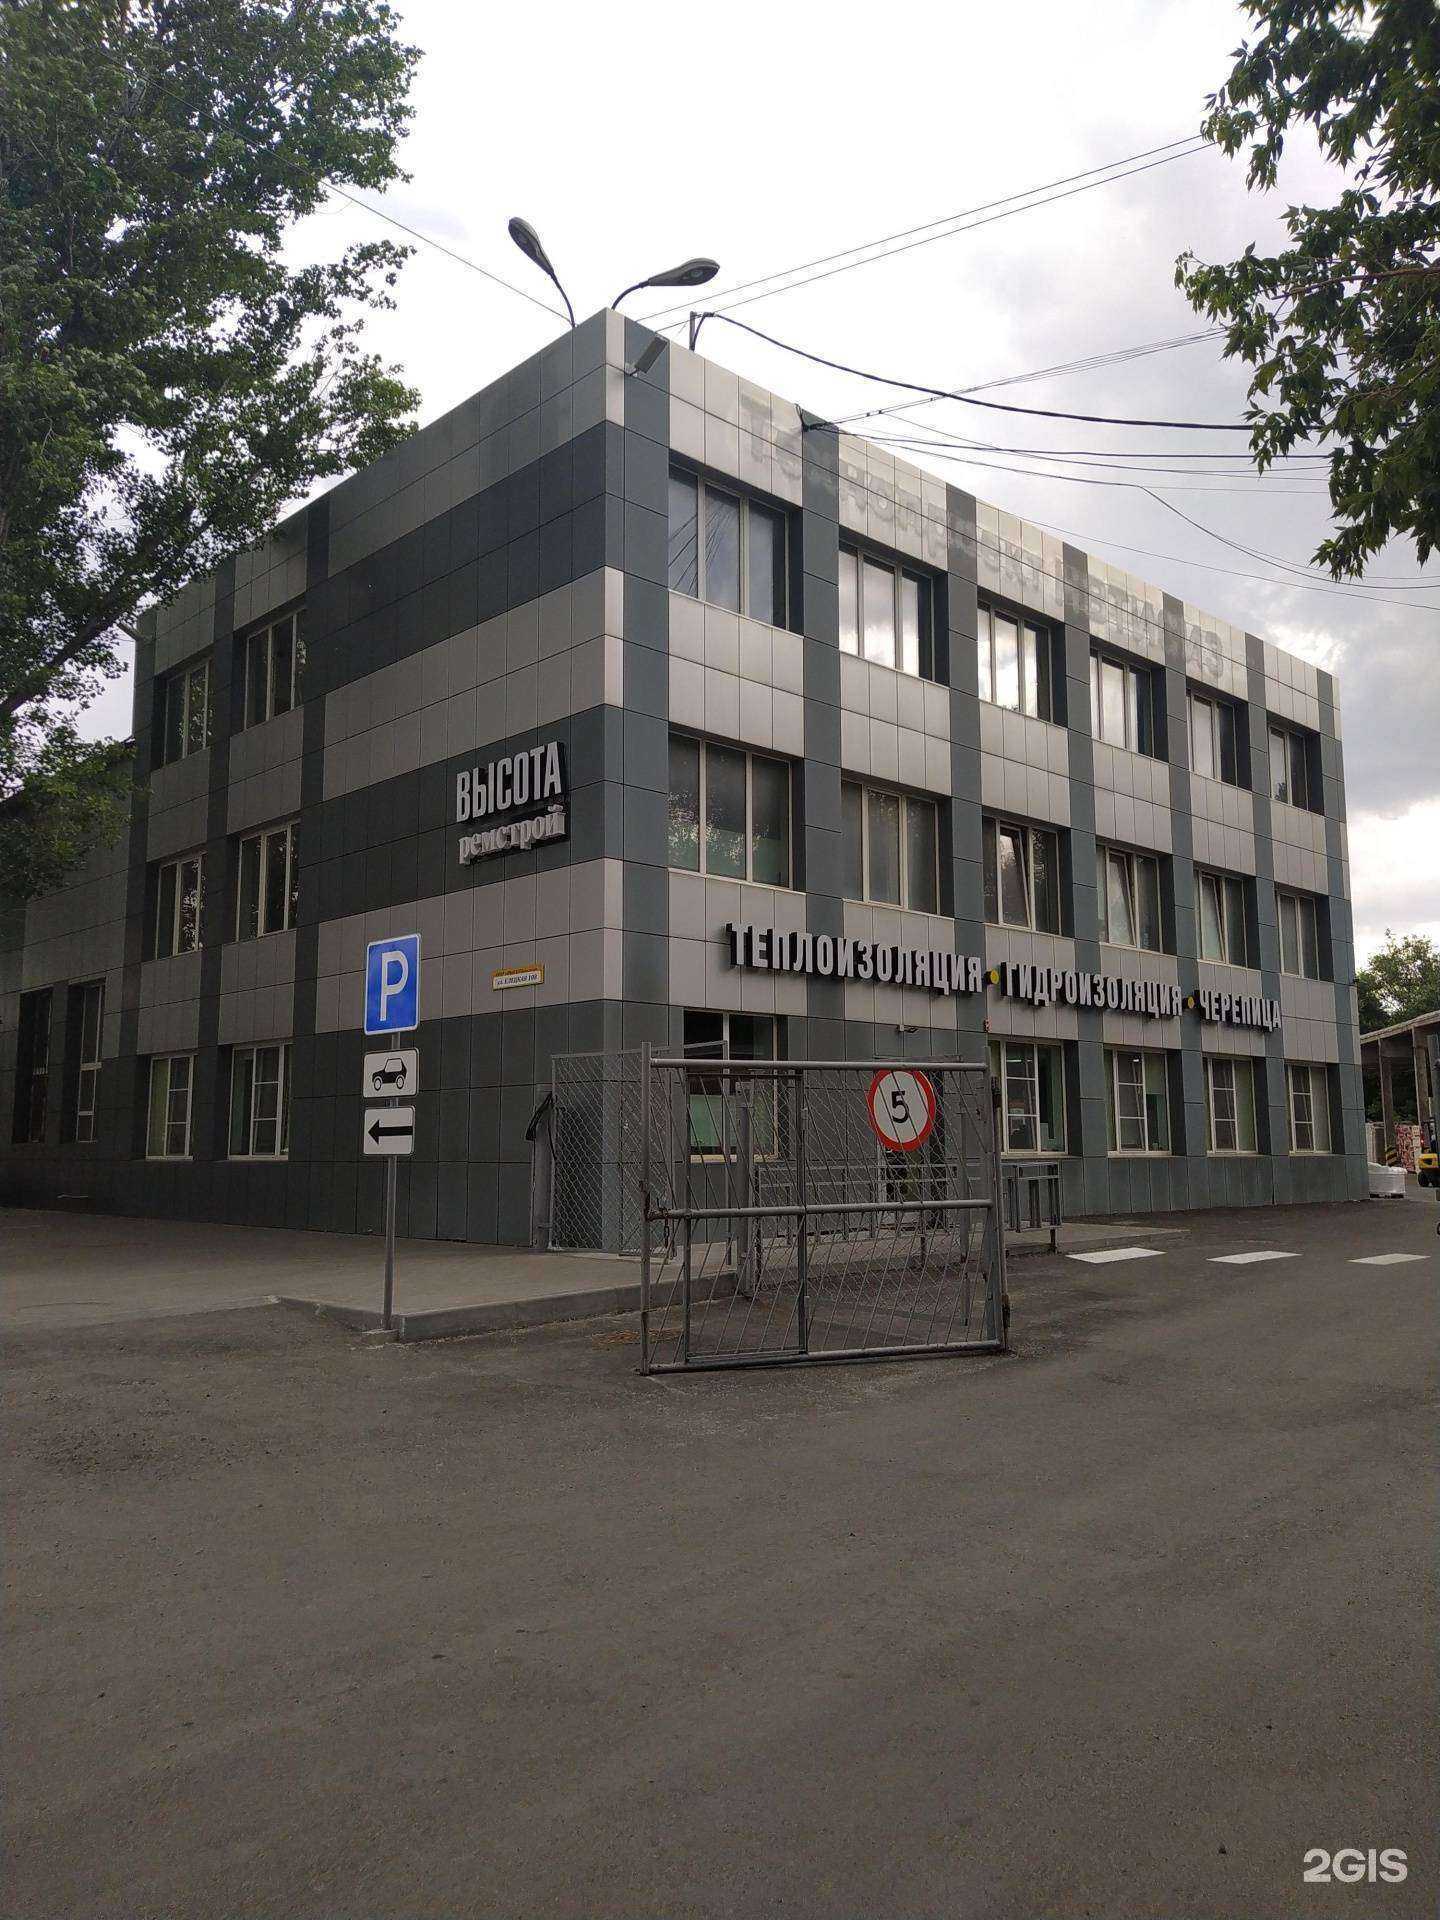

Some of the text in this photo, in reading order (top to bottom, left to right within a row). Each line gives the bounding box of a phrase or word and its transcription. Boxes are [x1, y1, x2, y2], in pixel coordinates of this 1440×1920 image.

[456, 741, 562, 822] ВЫСОТА
[459, 803, 566, 864] ремстрой
[728, 924, 1282, 1031] ТЕПЛОИЗОЛЯЦИЯ ГИДРОИЗОЛЯЦИЯ ЧЕРЕПИЦА
[891, 1090, 909, 1123] 5
